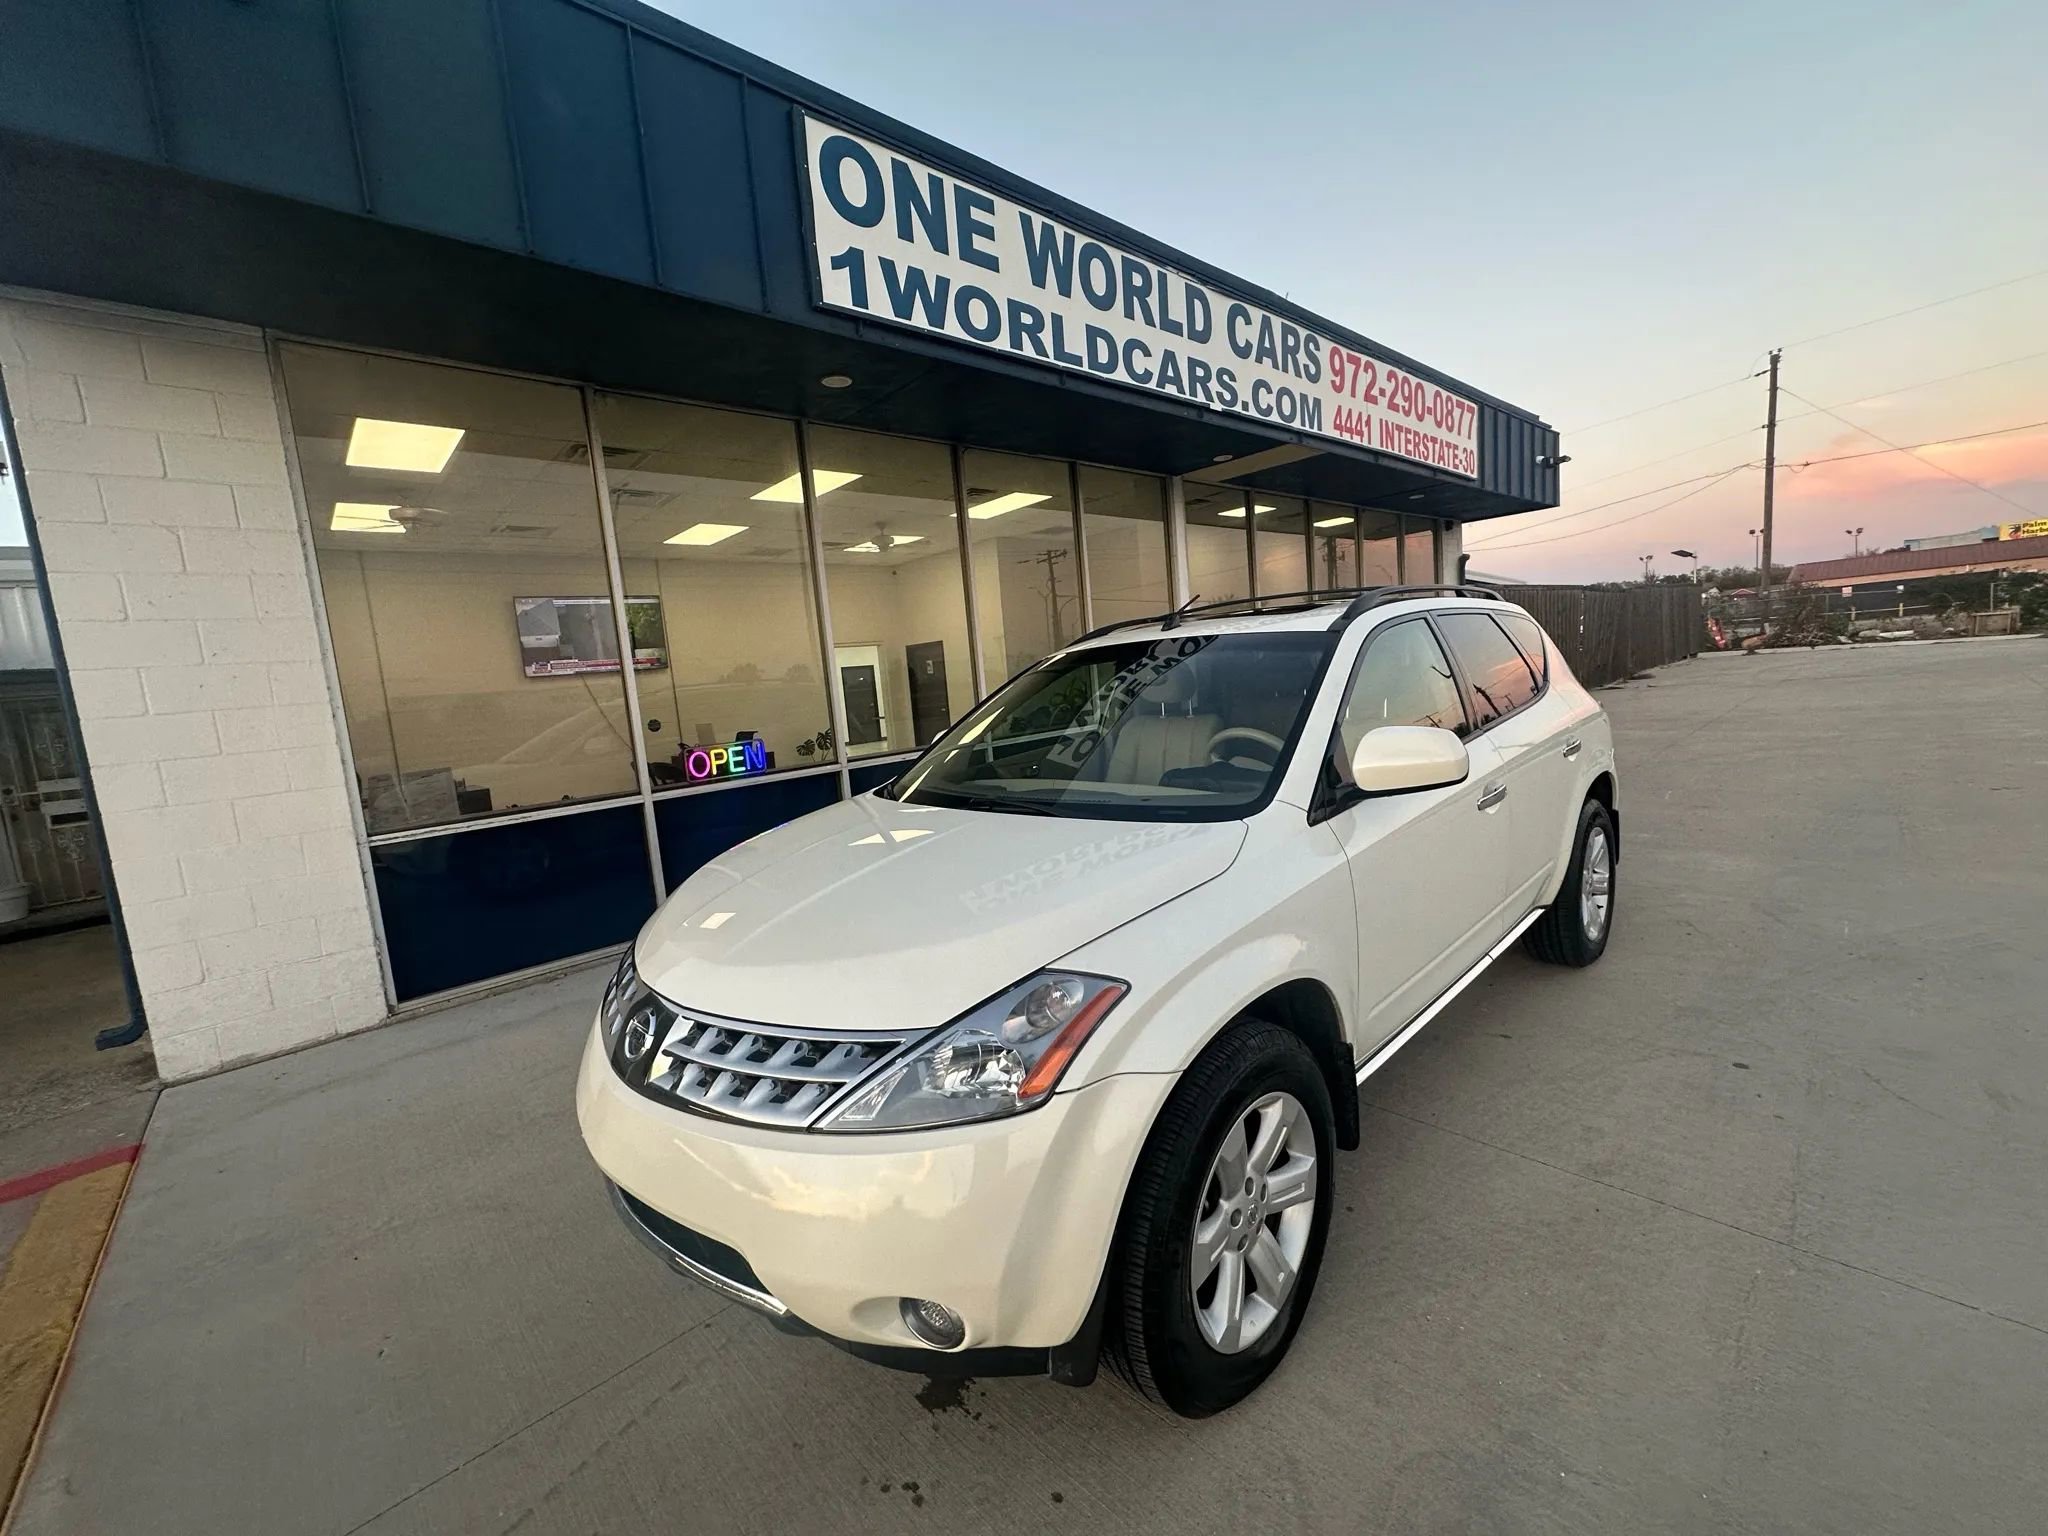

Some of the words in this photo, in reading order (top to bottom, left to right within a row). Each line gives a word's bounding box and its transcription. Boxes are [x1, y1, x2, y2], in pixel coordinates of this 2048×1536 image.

[819, 135, 1000, 273] ONE
[1018, 210, 1212, 345] WORLD
[1226, 303, 1322, 384] CARS
[830, 246, 1323, 432] 1WORLDCARS.COM
[1329, 346, 1476, 440] 972-290-0877
[1333, 405, 1373, 446] 4441
[1379, 418, 1475, 475] INTERSTATE-30
[688, 739, 765, 778] OPEN
